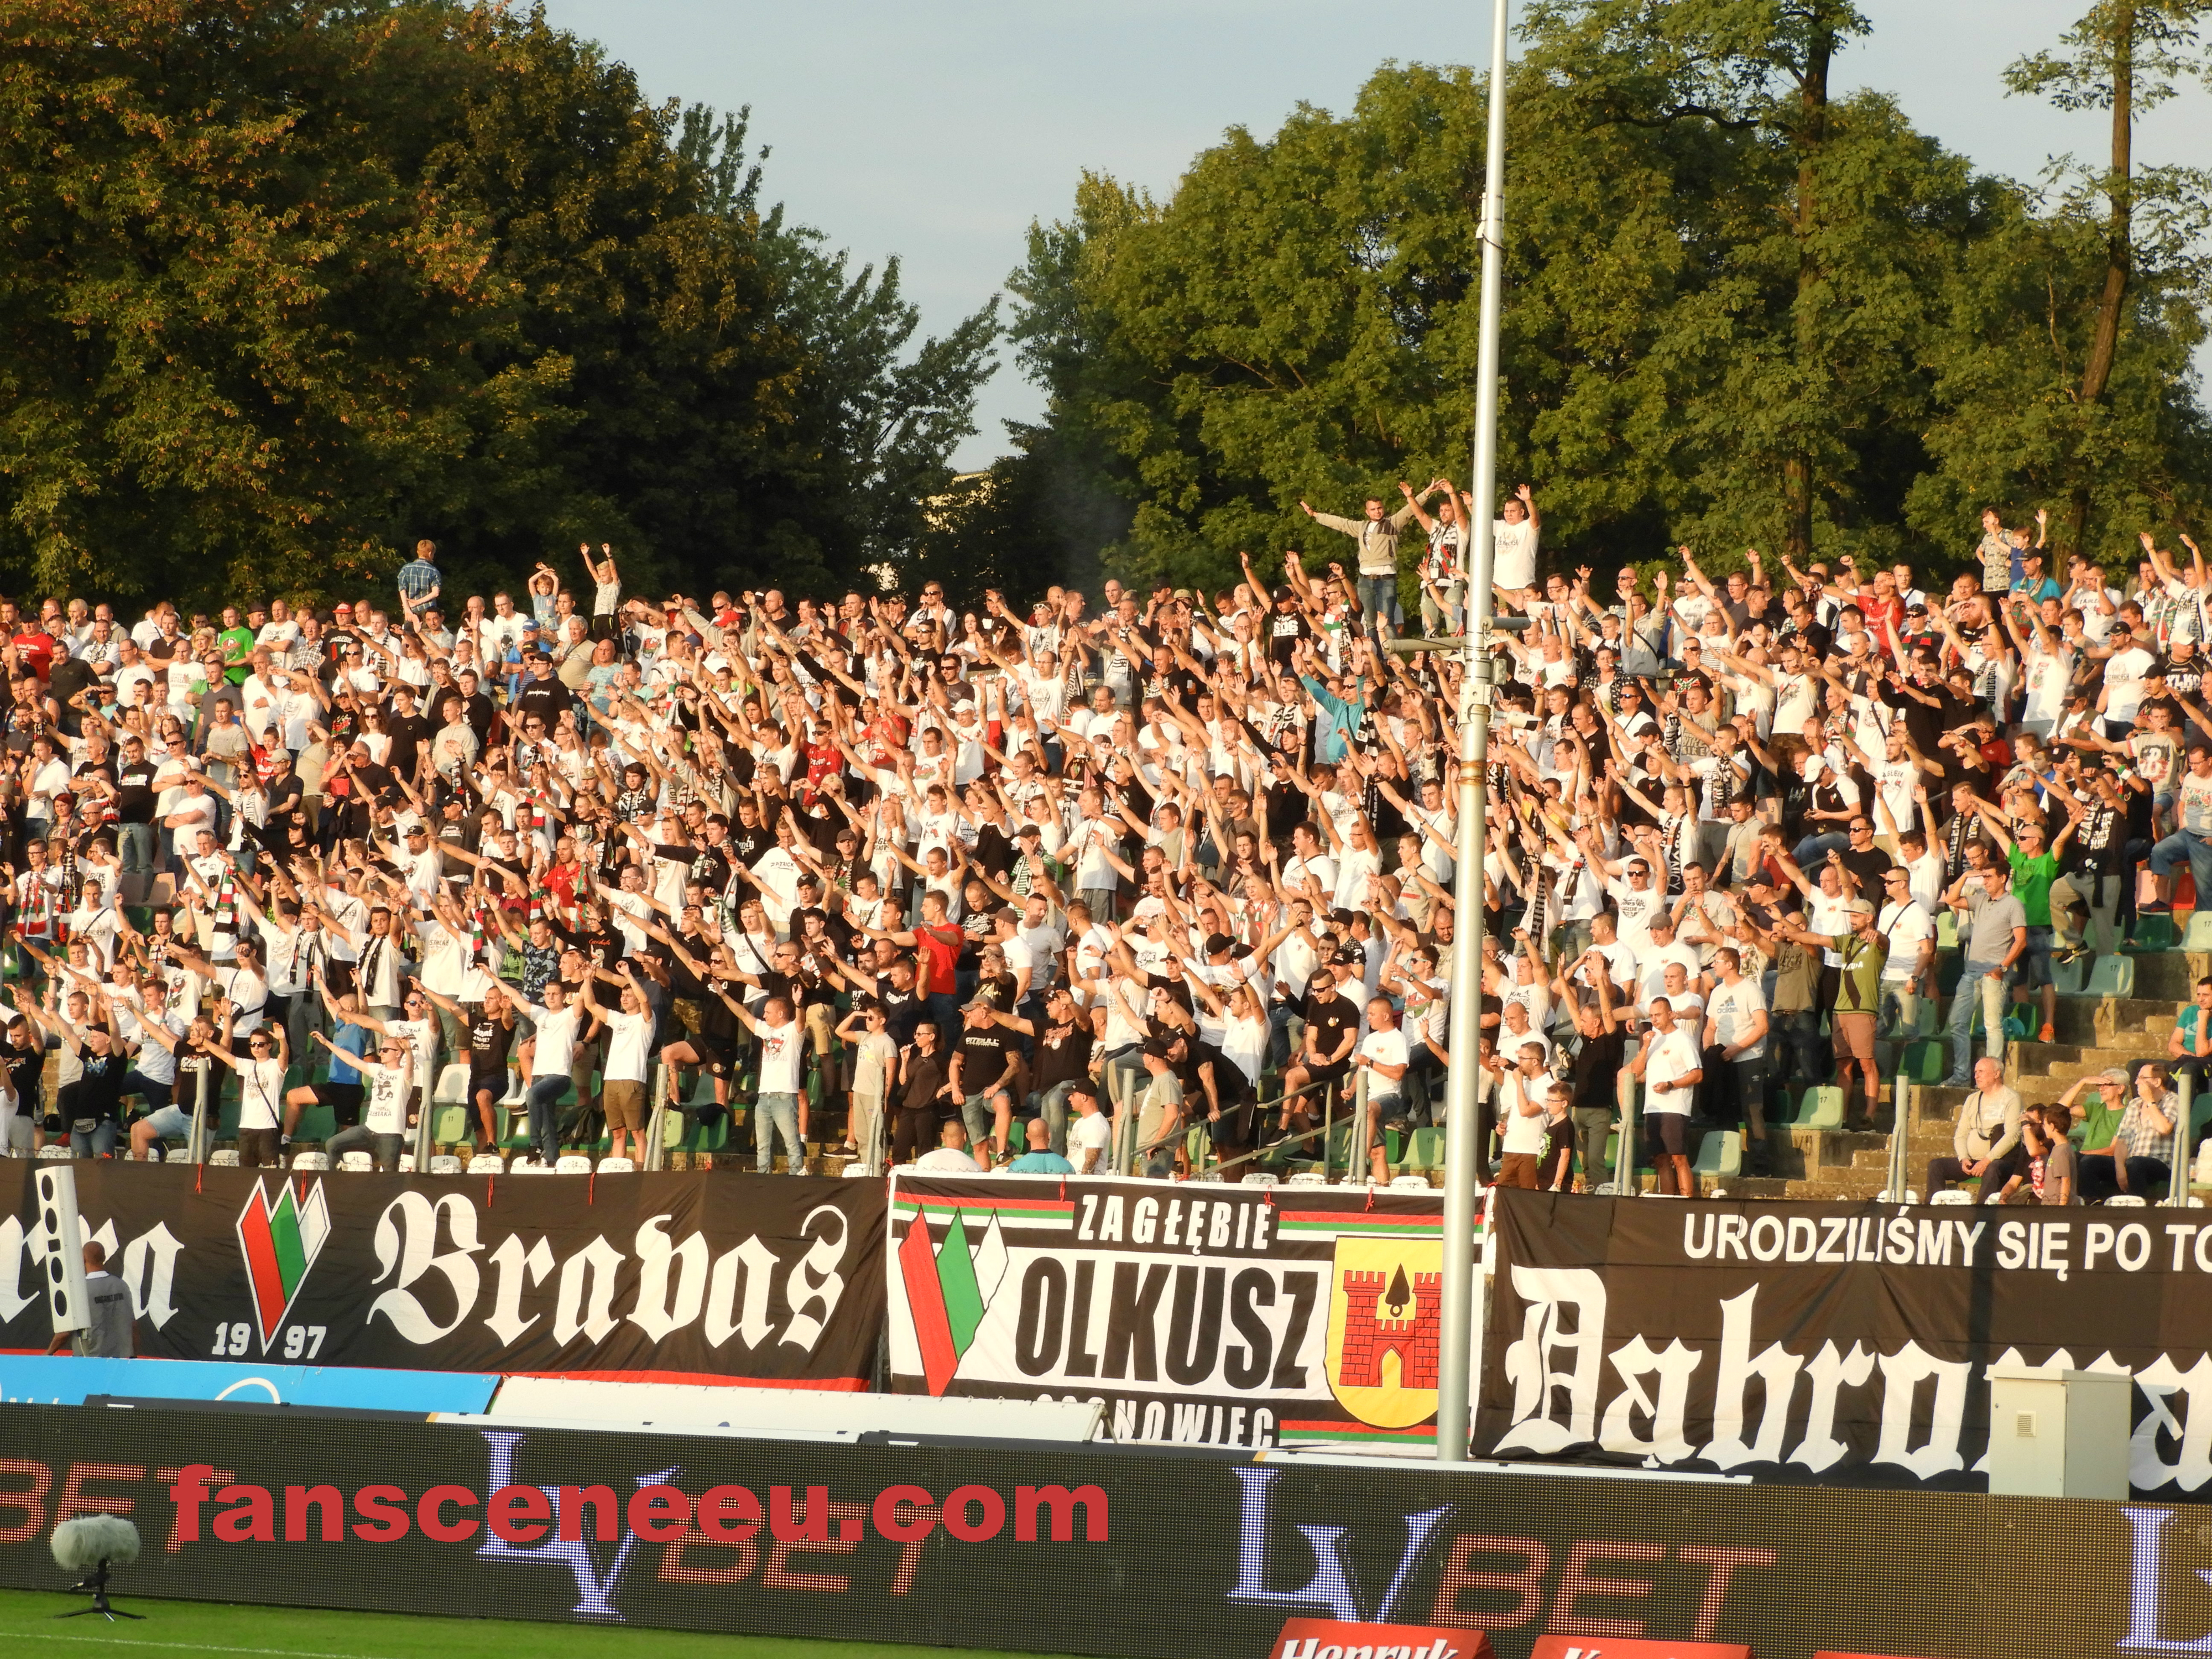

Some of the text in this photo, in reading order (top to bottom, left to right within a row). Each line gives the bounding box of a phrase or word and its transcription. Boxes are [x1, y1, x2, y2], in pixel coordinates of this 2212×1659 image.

[1078, 1194, 1272, 1256] ZAGŁĘBIE
[1684, 1206, 1986, 1266] URODZILIŚMY
[1996, 1220, 2070, 1282] SIĘ
[2084, 1223, 2151, 1272] PO
[366, 1191, 848, 1353] Bravas
[212, 1322, 327, 1359] 19 97
[1015, 1256, 1318, 1390] OLKUSZ
[1036, 1393, 1273, 1448] NOWIEC
[1491, 1262, 2212, 1492] Dąbroa
[1430, 1532, 1779, 1642] BET
